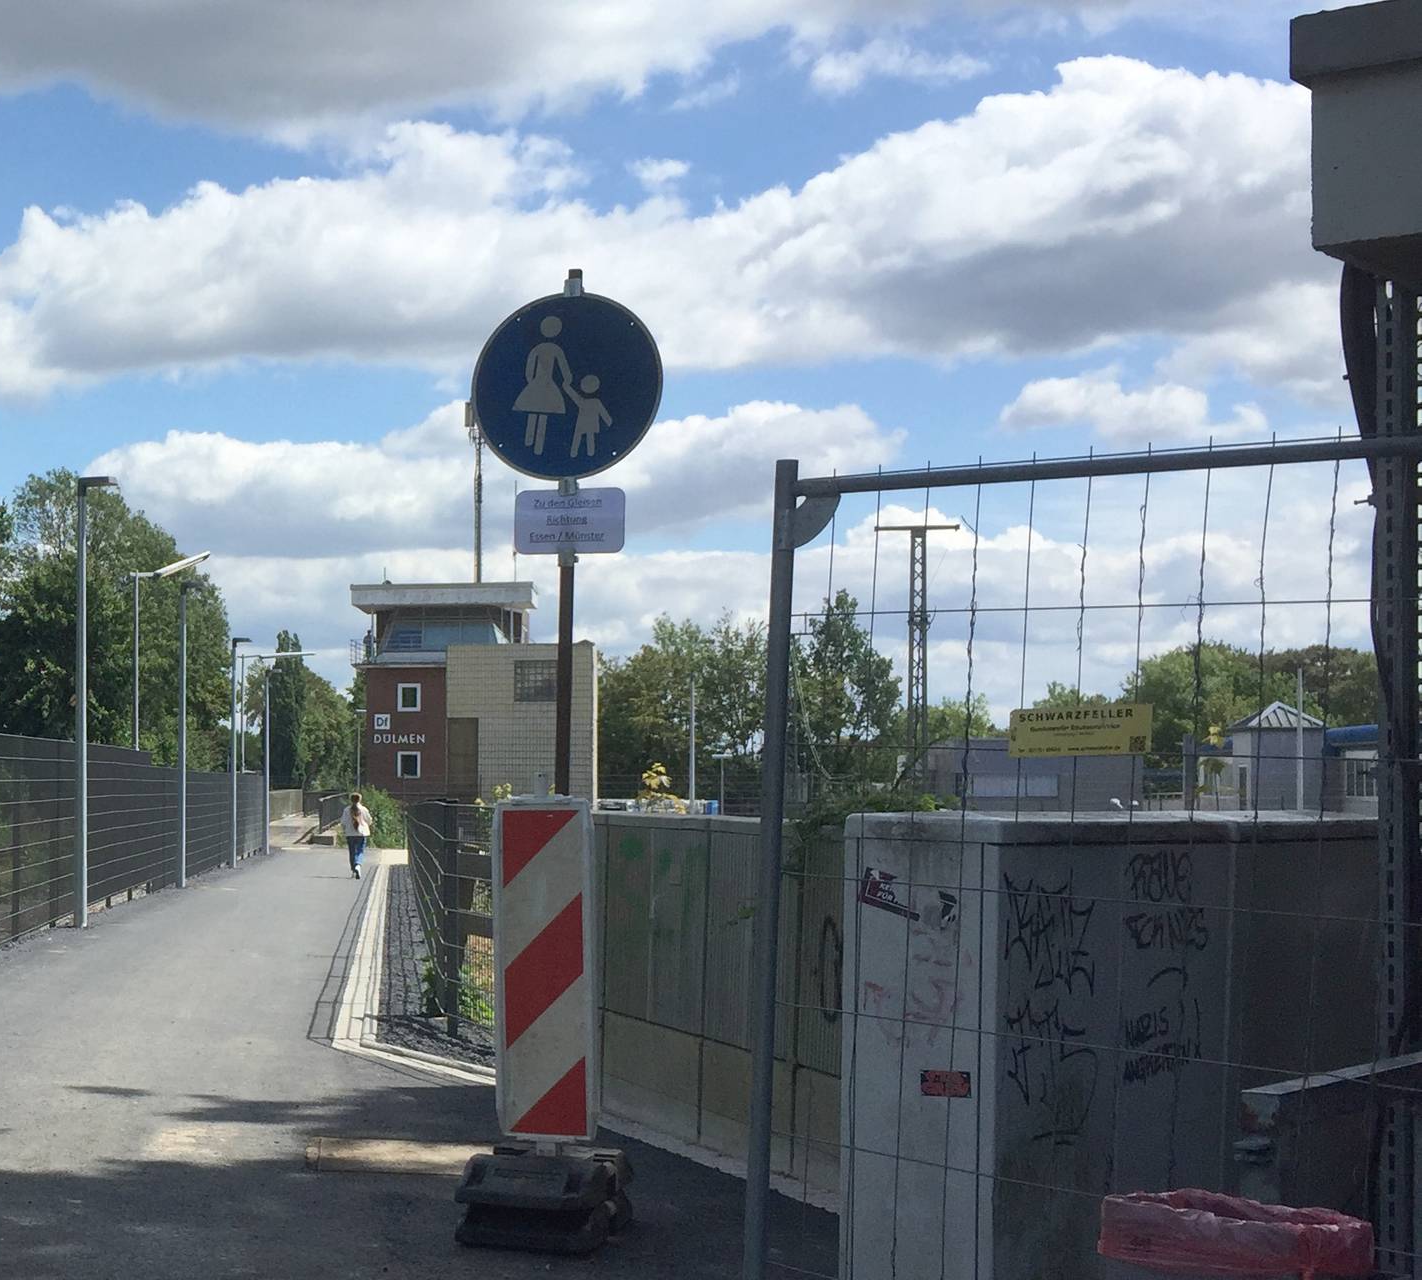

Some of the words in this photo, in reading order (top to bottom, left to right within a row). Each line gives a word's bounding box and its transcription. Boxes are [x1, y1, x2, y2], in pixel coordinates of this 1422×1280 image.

[534, 499, 545, 508] Zu
[548, 499, 565, 508] den
[568, 498, 602, 508] Gleisen
[546, 514, 588, 526] Richtung
[530, 532, 556, 542] Essen
[565, 531, 605, 542] Münster
[1019, 708, 1134, 723] SCHWARZFELLER
[373, 733, 426, 744] DÜLMEN
